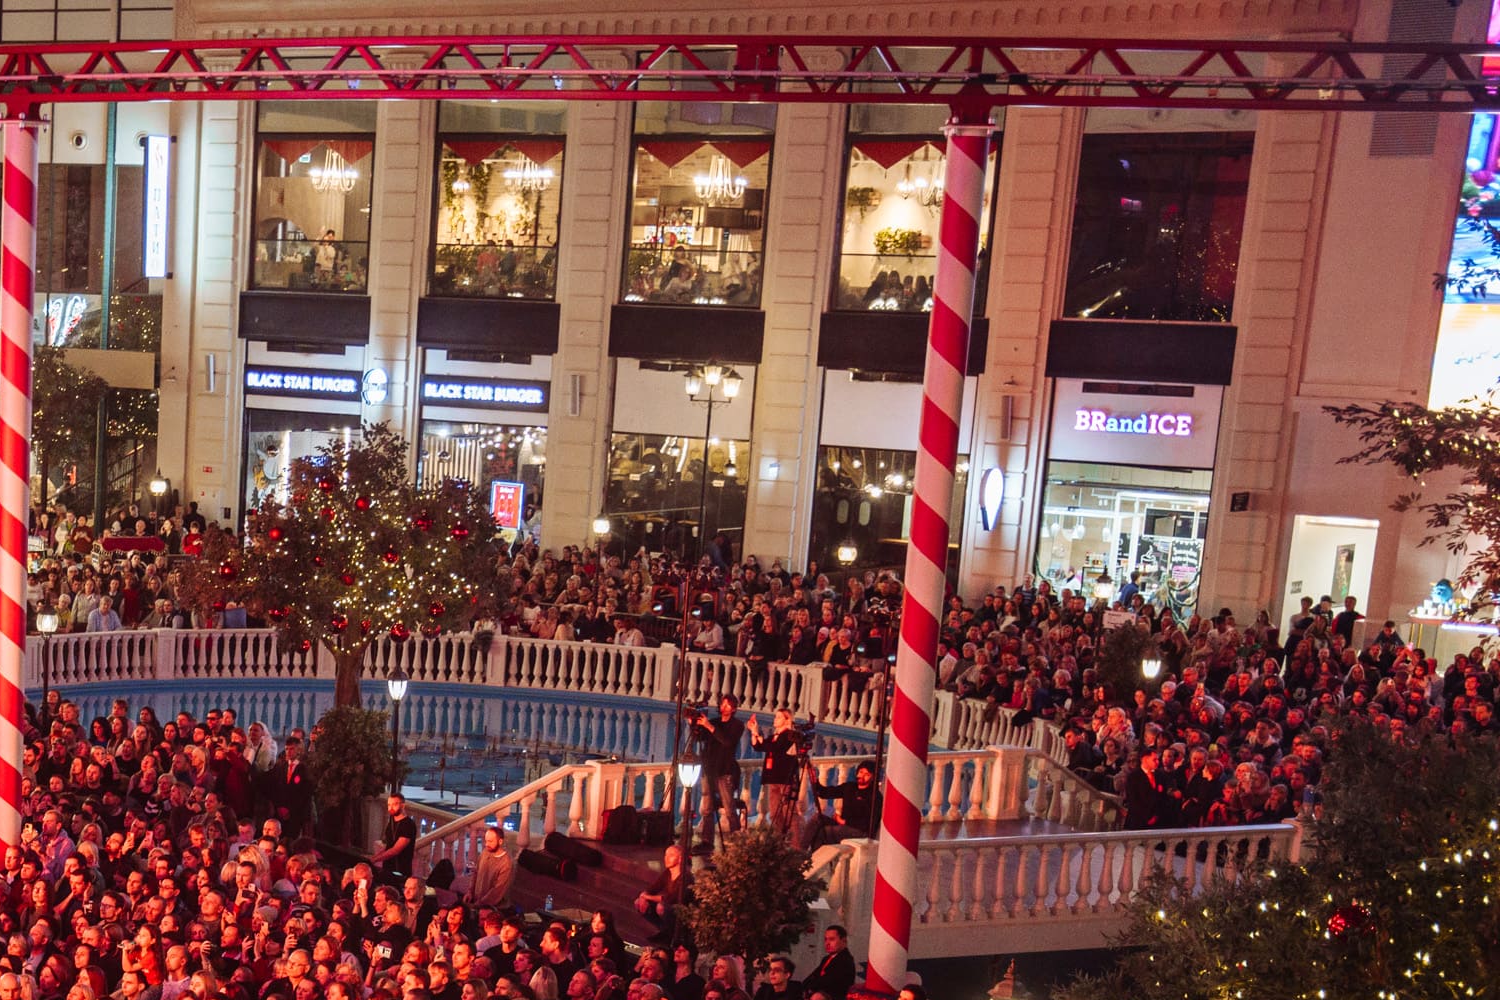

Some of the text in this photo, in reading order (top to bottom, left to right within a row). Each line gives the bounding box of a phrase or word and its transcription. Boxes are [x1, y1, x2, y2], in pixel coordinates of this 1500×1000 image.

[247, 371, 357, 393] BLACK STAR BURGER
[424, 382, 543, 404] BLACK STAR BURGER
[1074, 409, 1192, 436] BRandICE
